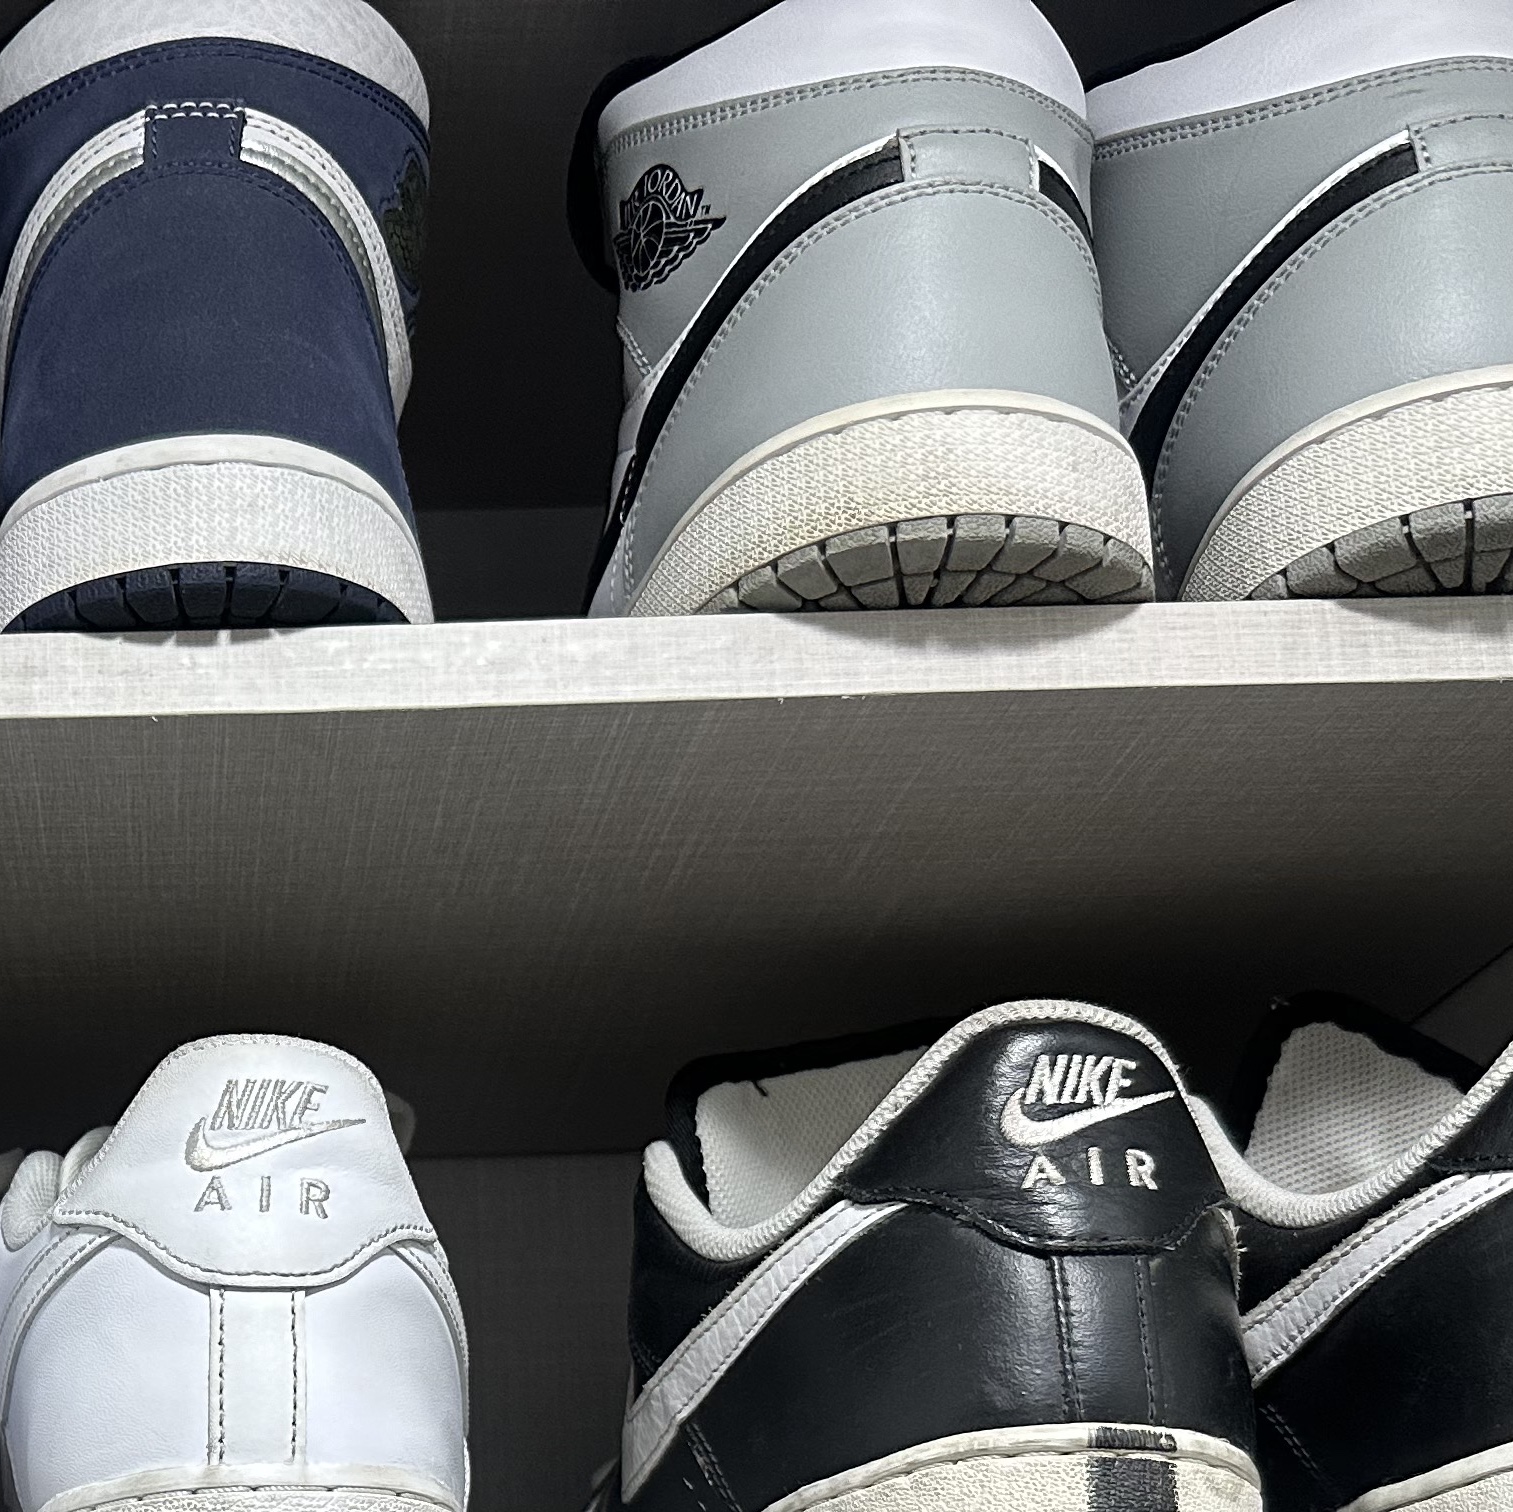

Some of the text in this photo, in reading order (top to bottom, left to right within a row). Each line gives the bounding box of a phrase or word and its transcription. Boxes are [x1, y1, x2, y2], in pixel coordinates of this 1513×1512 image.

[209, 1078, 331, 1131] NIKE
[1023, 1053, 1138, 1107] NIKE
[1020, 1146, 1159, 1192] AIR
[193, 1175, 331, 1220] AIR
